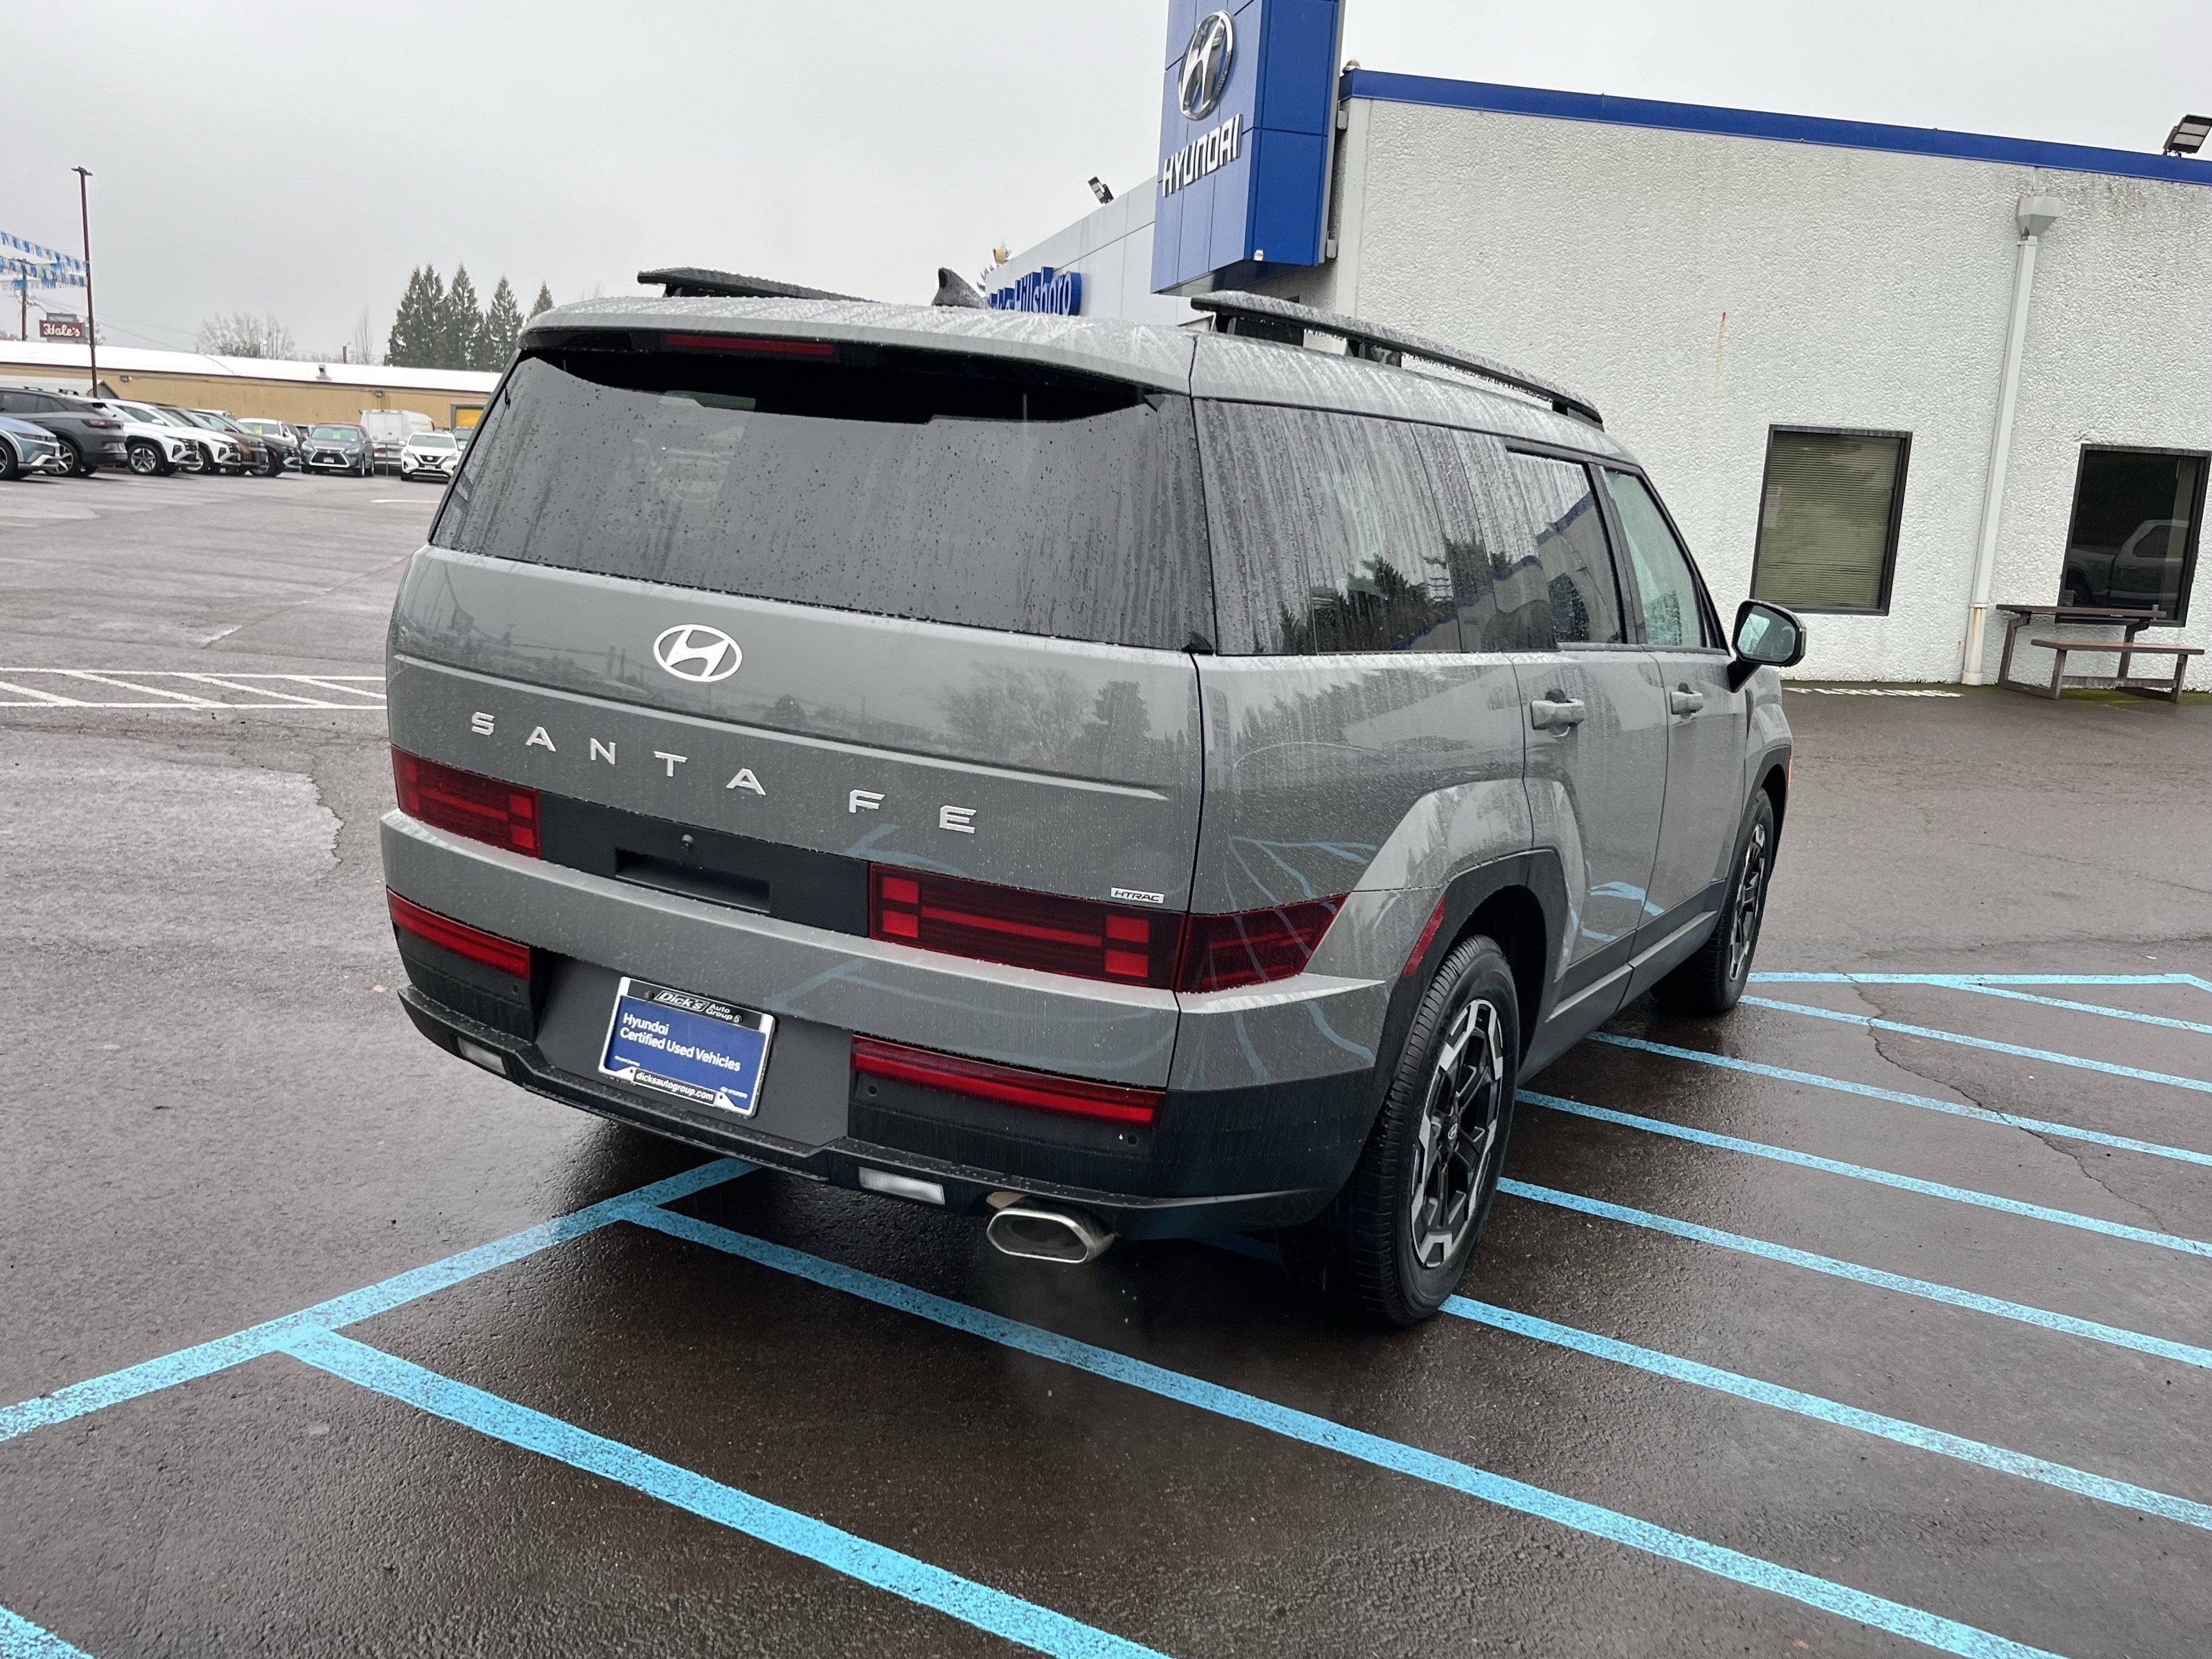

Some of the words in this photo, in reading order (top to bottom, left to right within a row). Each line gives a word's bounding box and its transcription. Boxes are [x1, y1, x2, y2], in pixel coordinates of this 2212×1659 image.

[1163, 114, 1244, 198] HYUNDAI
[43, 323, 81, 337] Hale's
[471, 712, 766, 796] SANTA
[849, 789, 977, 834] FE
[1115, 890, 1160, 901] HTRAC
[658, 992, 703, 1010] Dick's
[709, 1003, 731, 1013] Auto
[623, 1012, 670, 1036] Hyundai
[706, 1008, 733, 1021] Group
[620, 1027, 665, 1049] Certified
[667, 1040, 695, 1058] Used
[696, 1048, 741, 1071] Vehicles
[635, 1071, 714, 1101] dicksautogroup.com
